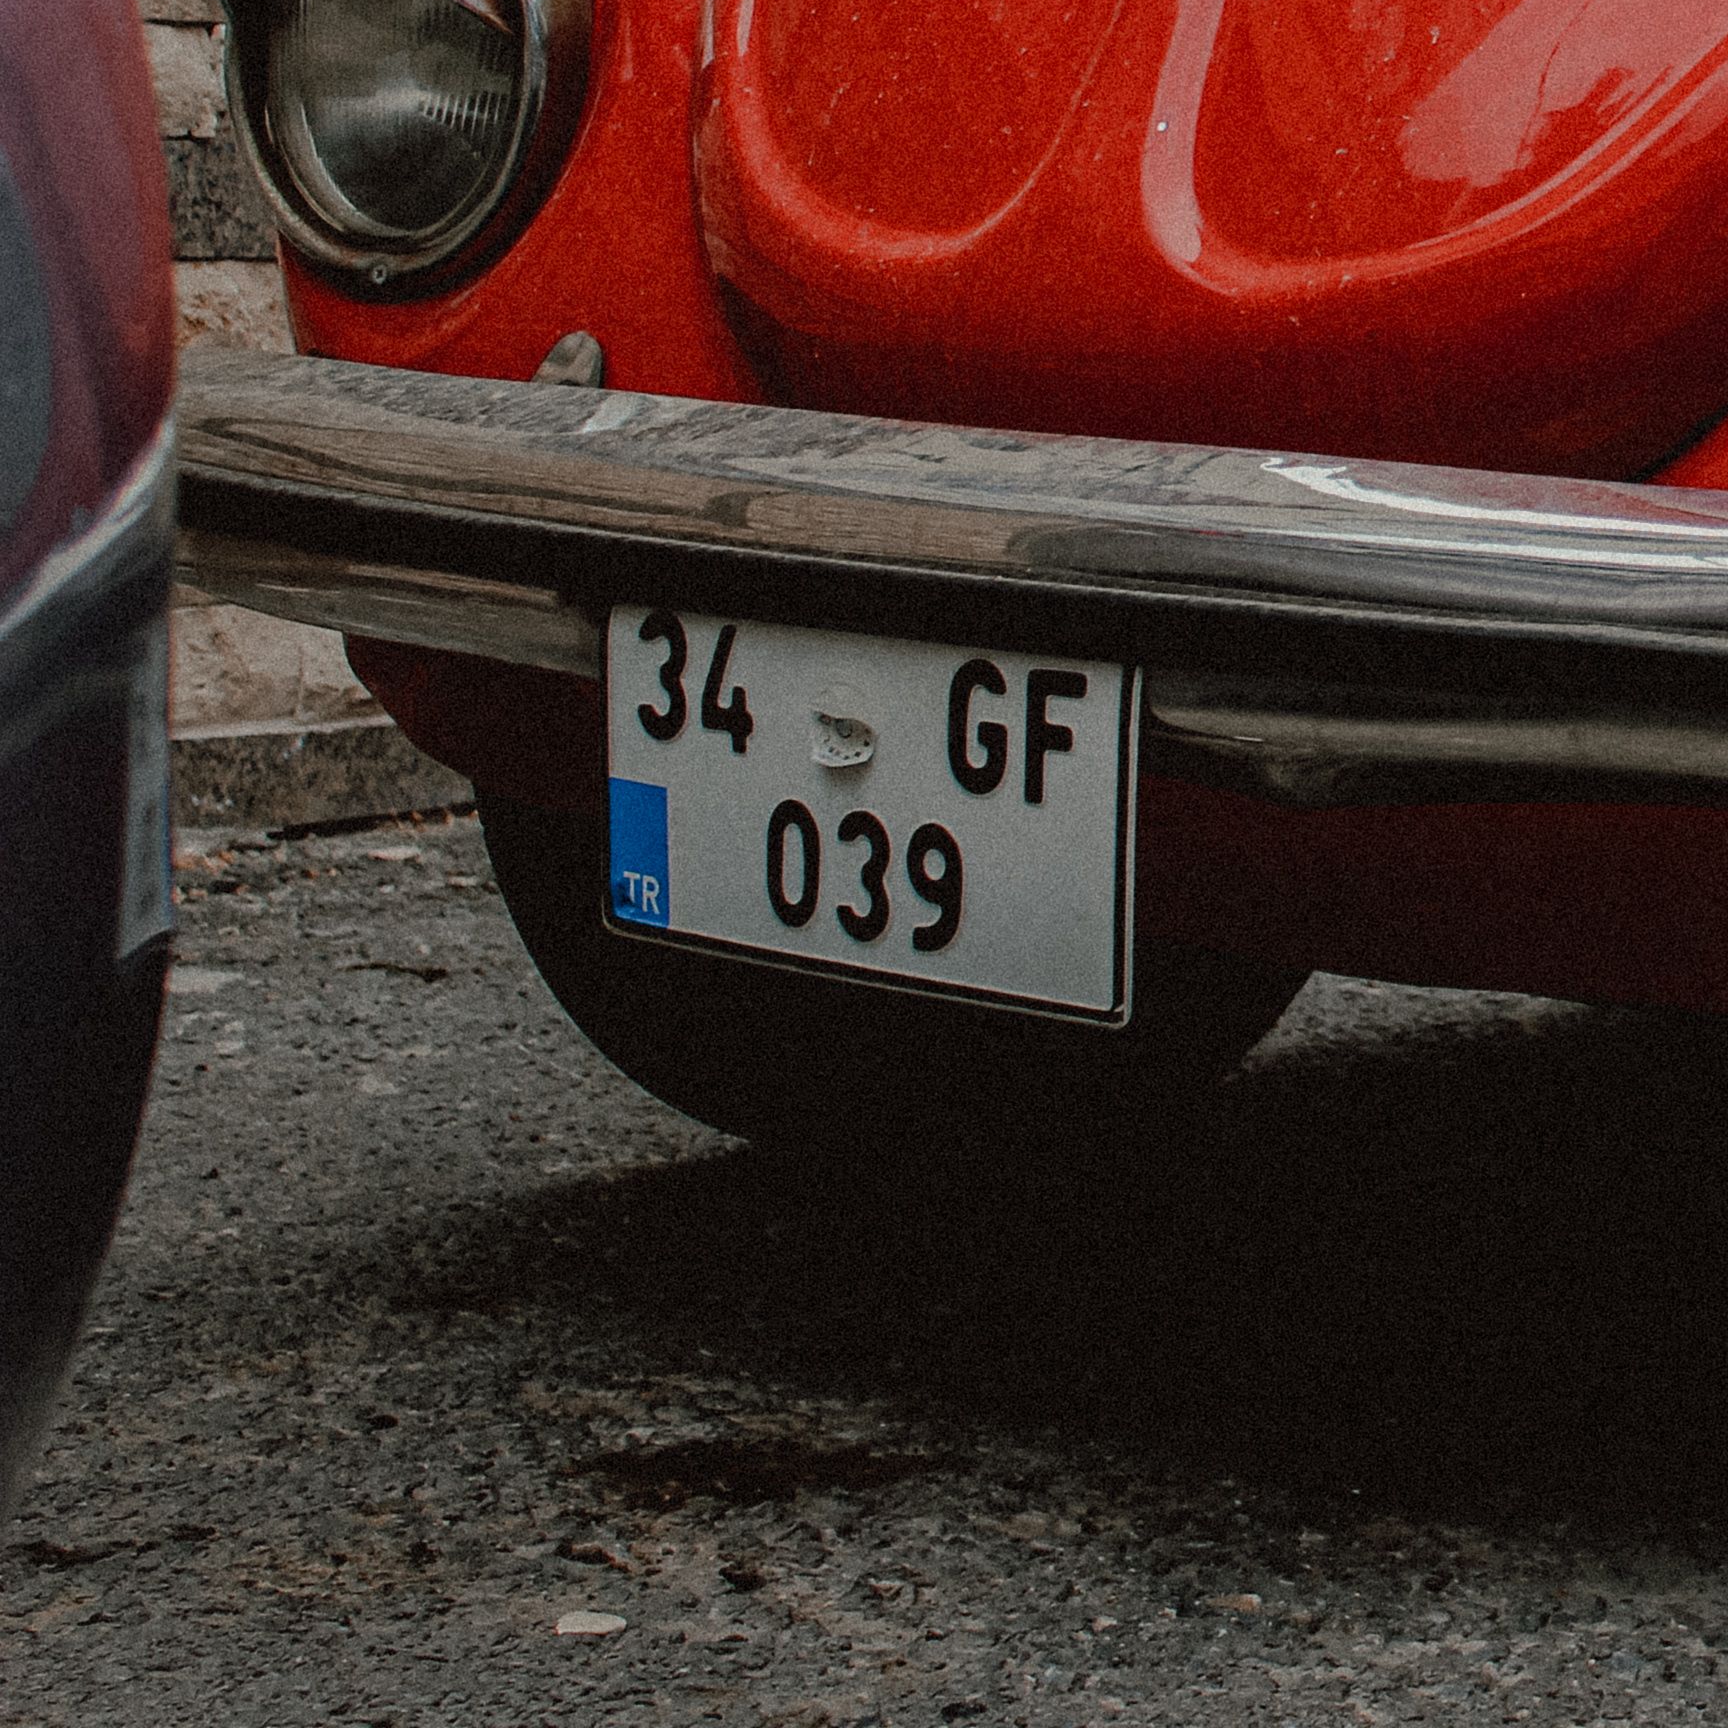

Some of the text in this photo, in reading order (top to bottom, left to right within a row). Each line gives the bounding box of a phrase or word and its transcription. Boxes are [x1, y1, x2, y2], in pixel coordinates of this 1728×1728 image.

[638, 610, 1088, 804] 34 GF
[623, 871, 660, 914] TR
[766, 799, 964, 953] 039
